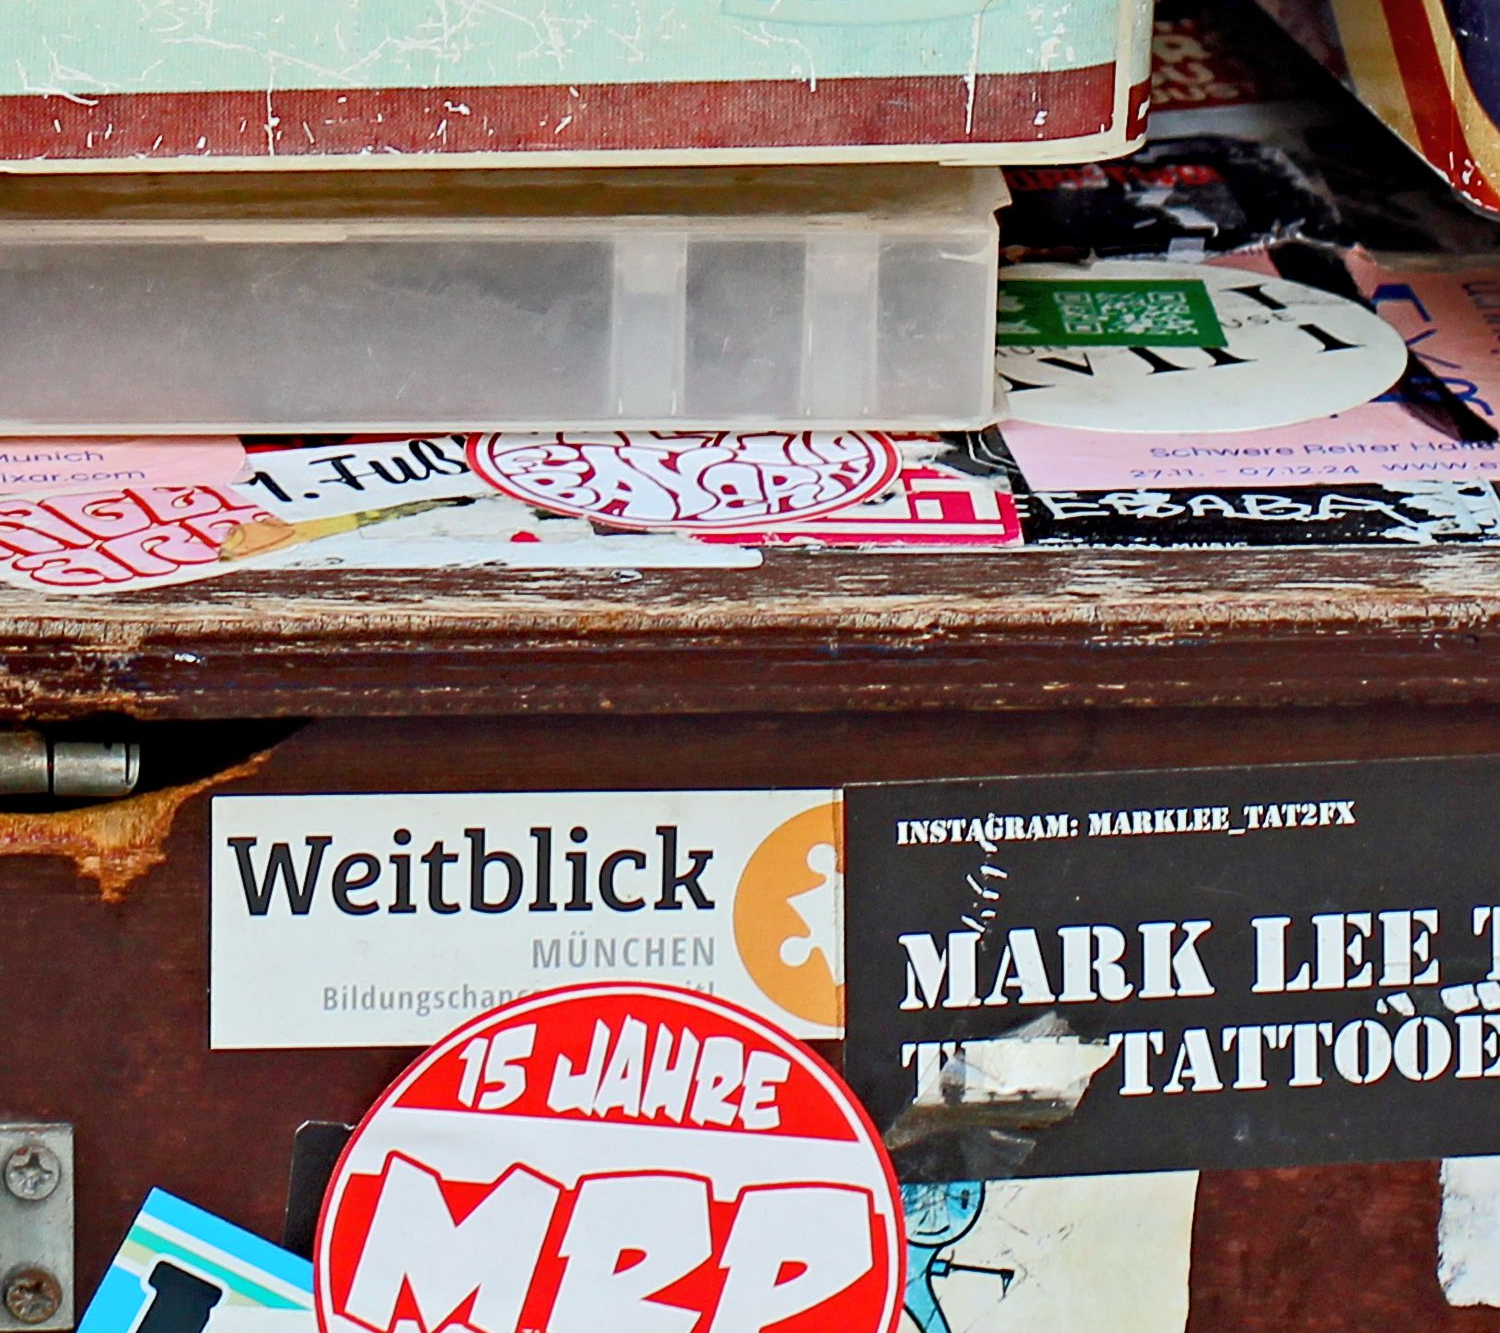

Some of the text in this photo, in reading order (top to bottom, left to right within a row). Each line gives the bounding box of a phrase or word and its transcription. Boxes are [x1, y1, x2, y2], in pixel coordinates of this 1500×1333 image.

[1148, 444, 1295, 461] Schwere
[1302, 441, 1402, 457] Reiter
[896, 800, 1357, 846] INSTAGRAM: MARKLEE_TAT2FX
[226, 824, 716, 920] Weitblick
[531, 930, 717, 970] MÜNCHEN
[898, 921, 1215, 1014] MARK
[1249, 906, 1440, 997] LEE
[321, 982, 540, 1018] Bildungschan
[455, 1023, 530, 1112] 15
[553, 1012, 792, 1132] JAHRE
